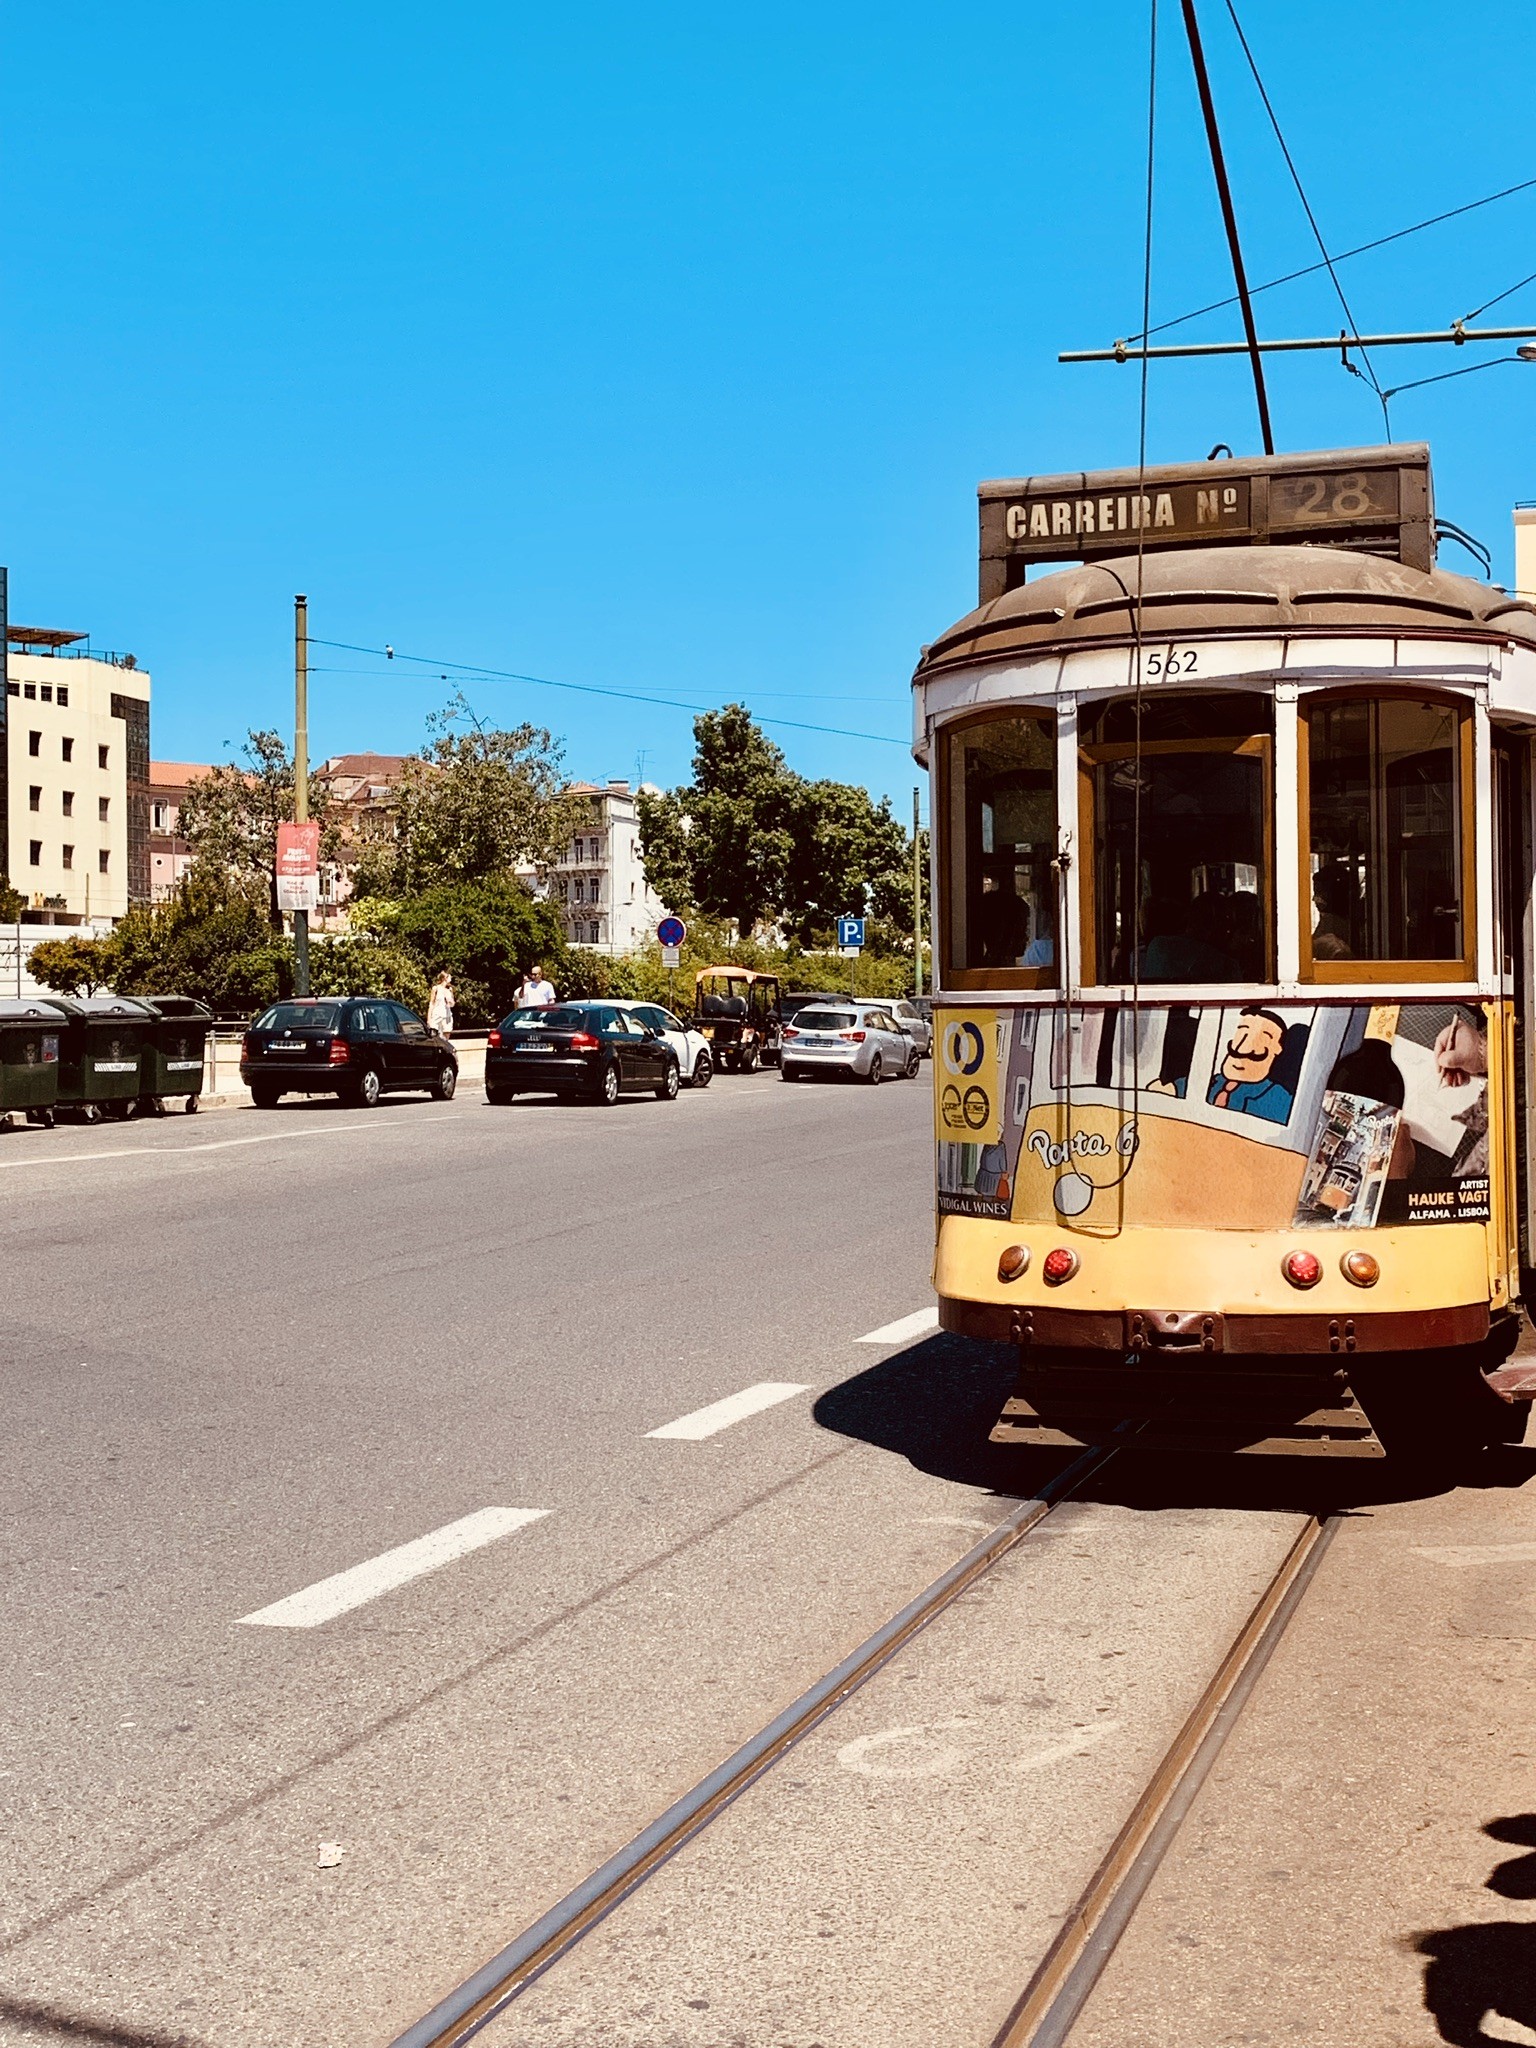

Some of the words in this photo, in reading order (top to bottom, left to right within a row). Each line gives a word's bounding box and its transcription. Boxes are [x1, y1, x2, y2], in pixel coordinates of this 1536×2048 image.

[1006, 493, 1176, 539] CARREIRA
[1294, 472, 1370, 520] 28
[1147, 650, 1198, 675] 562
[844, 921, 858, 942] P
[1027, 1130, 1111, 1169] Porta
[1115, 1119, 1140, 1157] 6
[1460, 1180, 1489, 1190] ARTIST
[939, 1197, 971, 1212] VIDIGAL
[973, 1201, 1007, 1215] WINES
[1408, 1192, 1455, 1206] HAUKE
[1458, 1190, 1489, 1204] VAGT
[1408, 1209, 1451, 1220] ALFAMA
[1457, 1206, 1489, 1217] LISBOA
